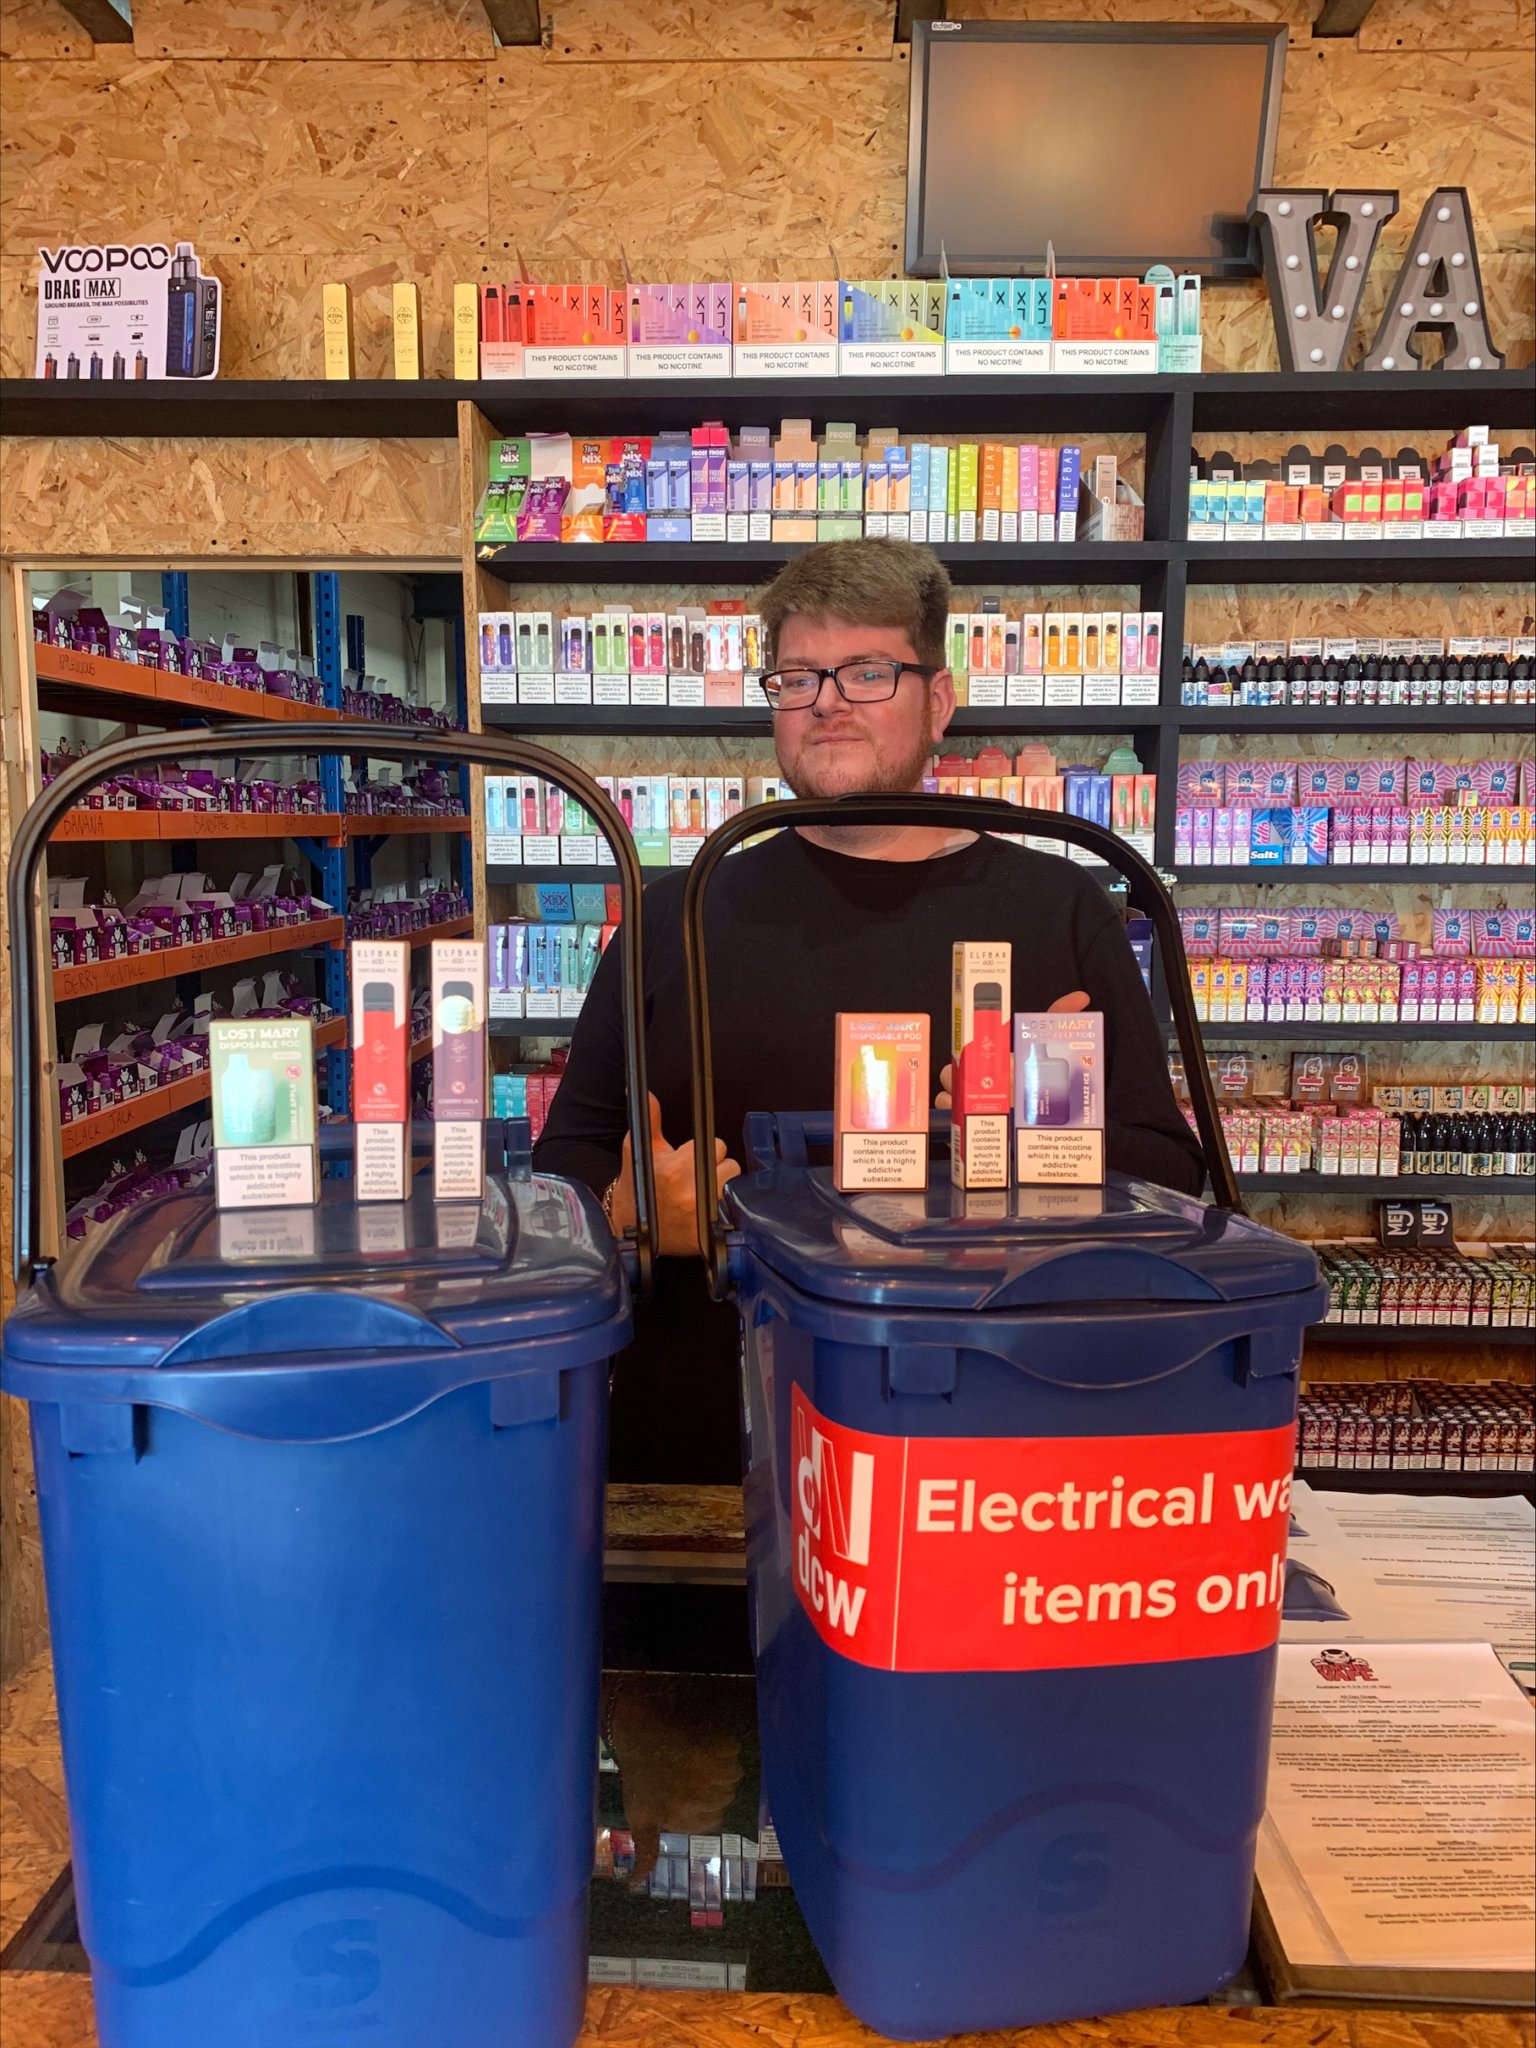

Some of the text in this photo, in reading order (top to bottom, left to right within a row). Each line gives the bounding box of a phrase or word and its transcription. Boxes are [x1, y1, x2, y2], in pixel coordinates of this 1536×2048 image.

[41, 246, 169, 274] VOOPOO
[44, 279, 117, 300] DRAG MAX
[1062, 448, 1074, 498] ELFBAR
[63, 814, 104, 835] BANANA
[1250, 851, 1279, 859] Salts
[357, 950, 398, 958] ELFBAR
[63, 969, 98, 995] BERRY
[218, 1027, 300, 1040] LOST MARY
[1058, 1020, 1094, 1030] MARY
[219, 1041, 278, 1050] DISPOSABLE
[108, 1109, 135, 1133] JACK
[259, 1153, 291, 1161] product
[246, 1182, 286, 1190] addictive
[275, 1172, 302, 1180] highly
[916, 1472, 1215, 1533] Electrical
[798, 1526, 867, 1637] dcw
[1003, 1572, 1177, 1626] items
